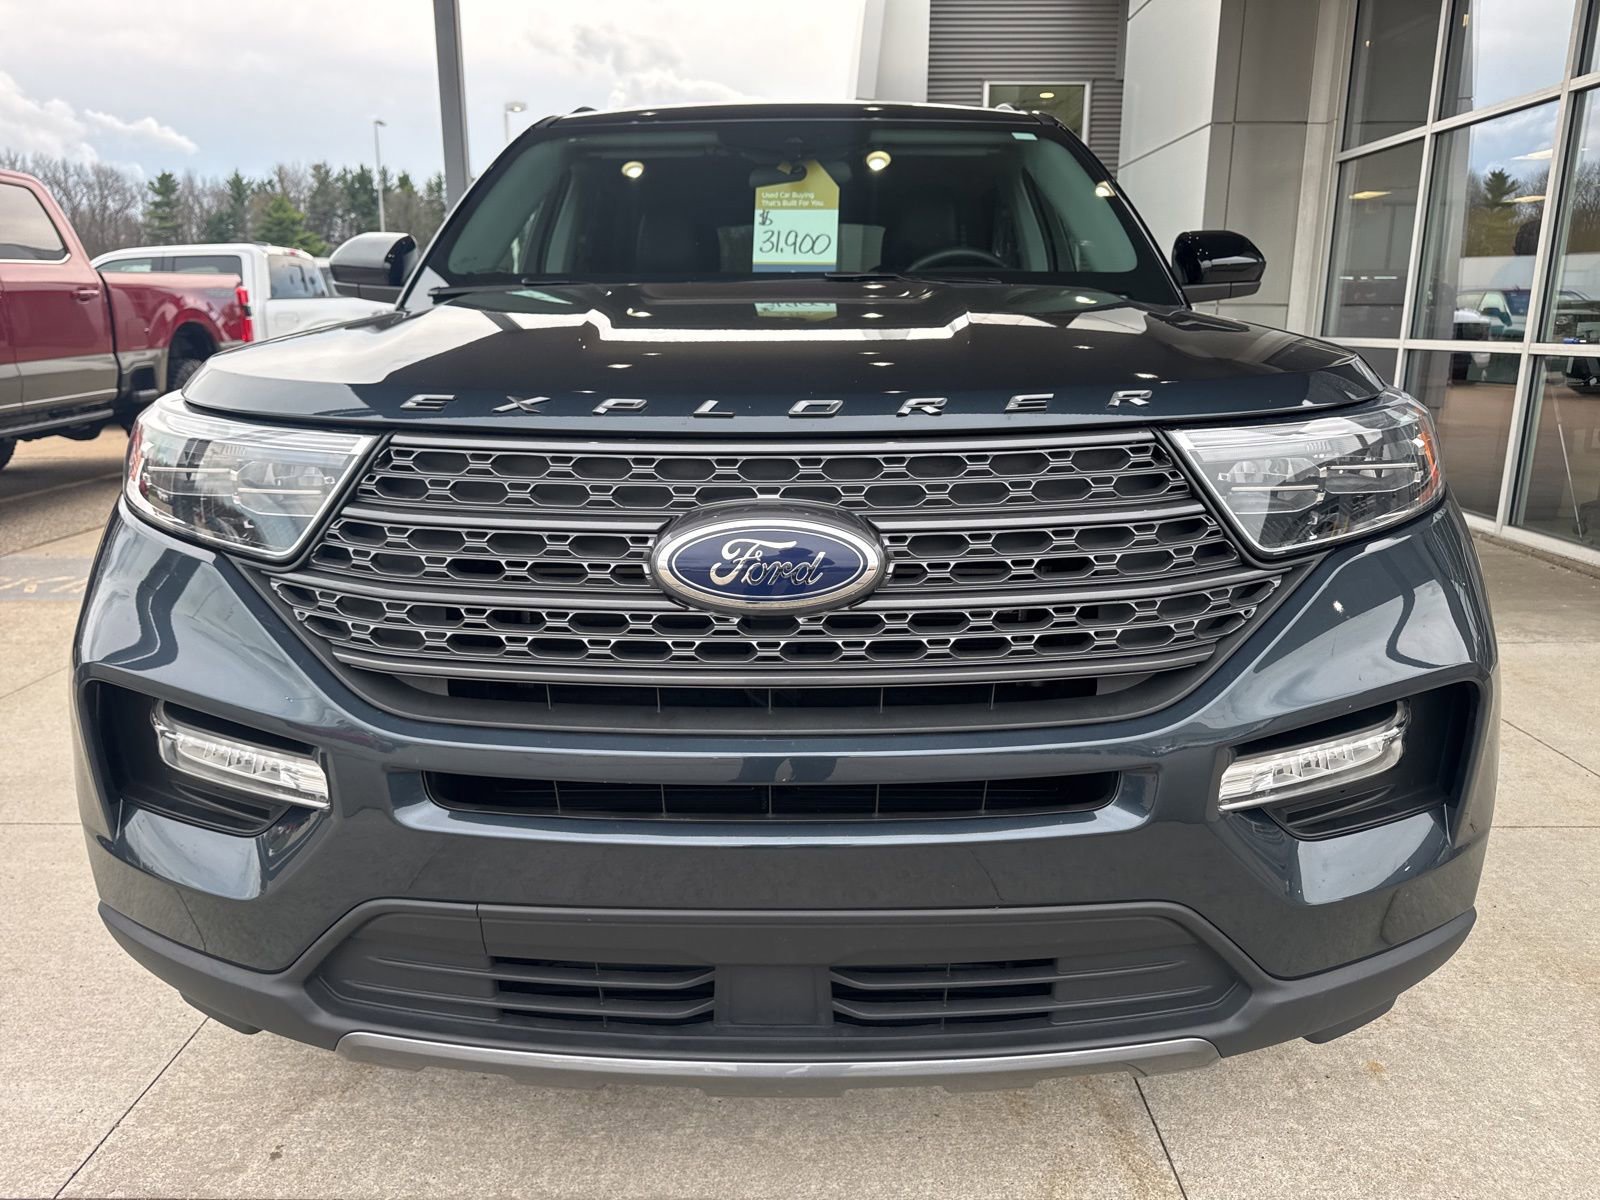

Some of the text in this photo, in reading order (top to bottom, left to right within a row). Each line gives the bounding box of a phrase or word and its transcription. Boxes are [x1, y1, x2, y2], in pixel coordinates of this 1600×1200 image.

[792, 192, 815, 200] Buying
[759, 209, 773, 226] $
[400, 390, 1153, 418] EXPLORER
[709, 538, 826, 586] Ford
